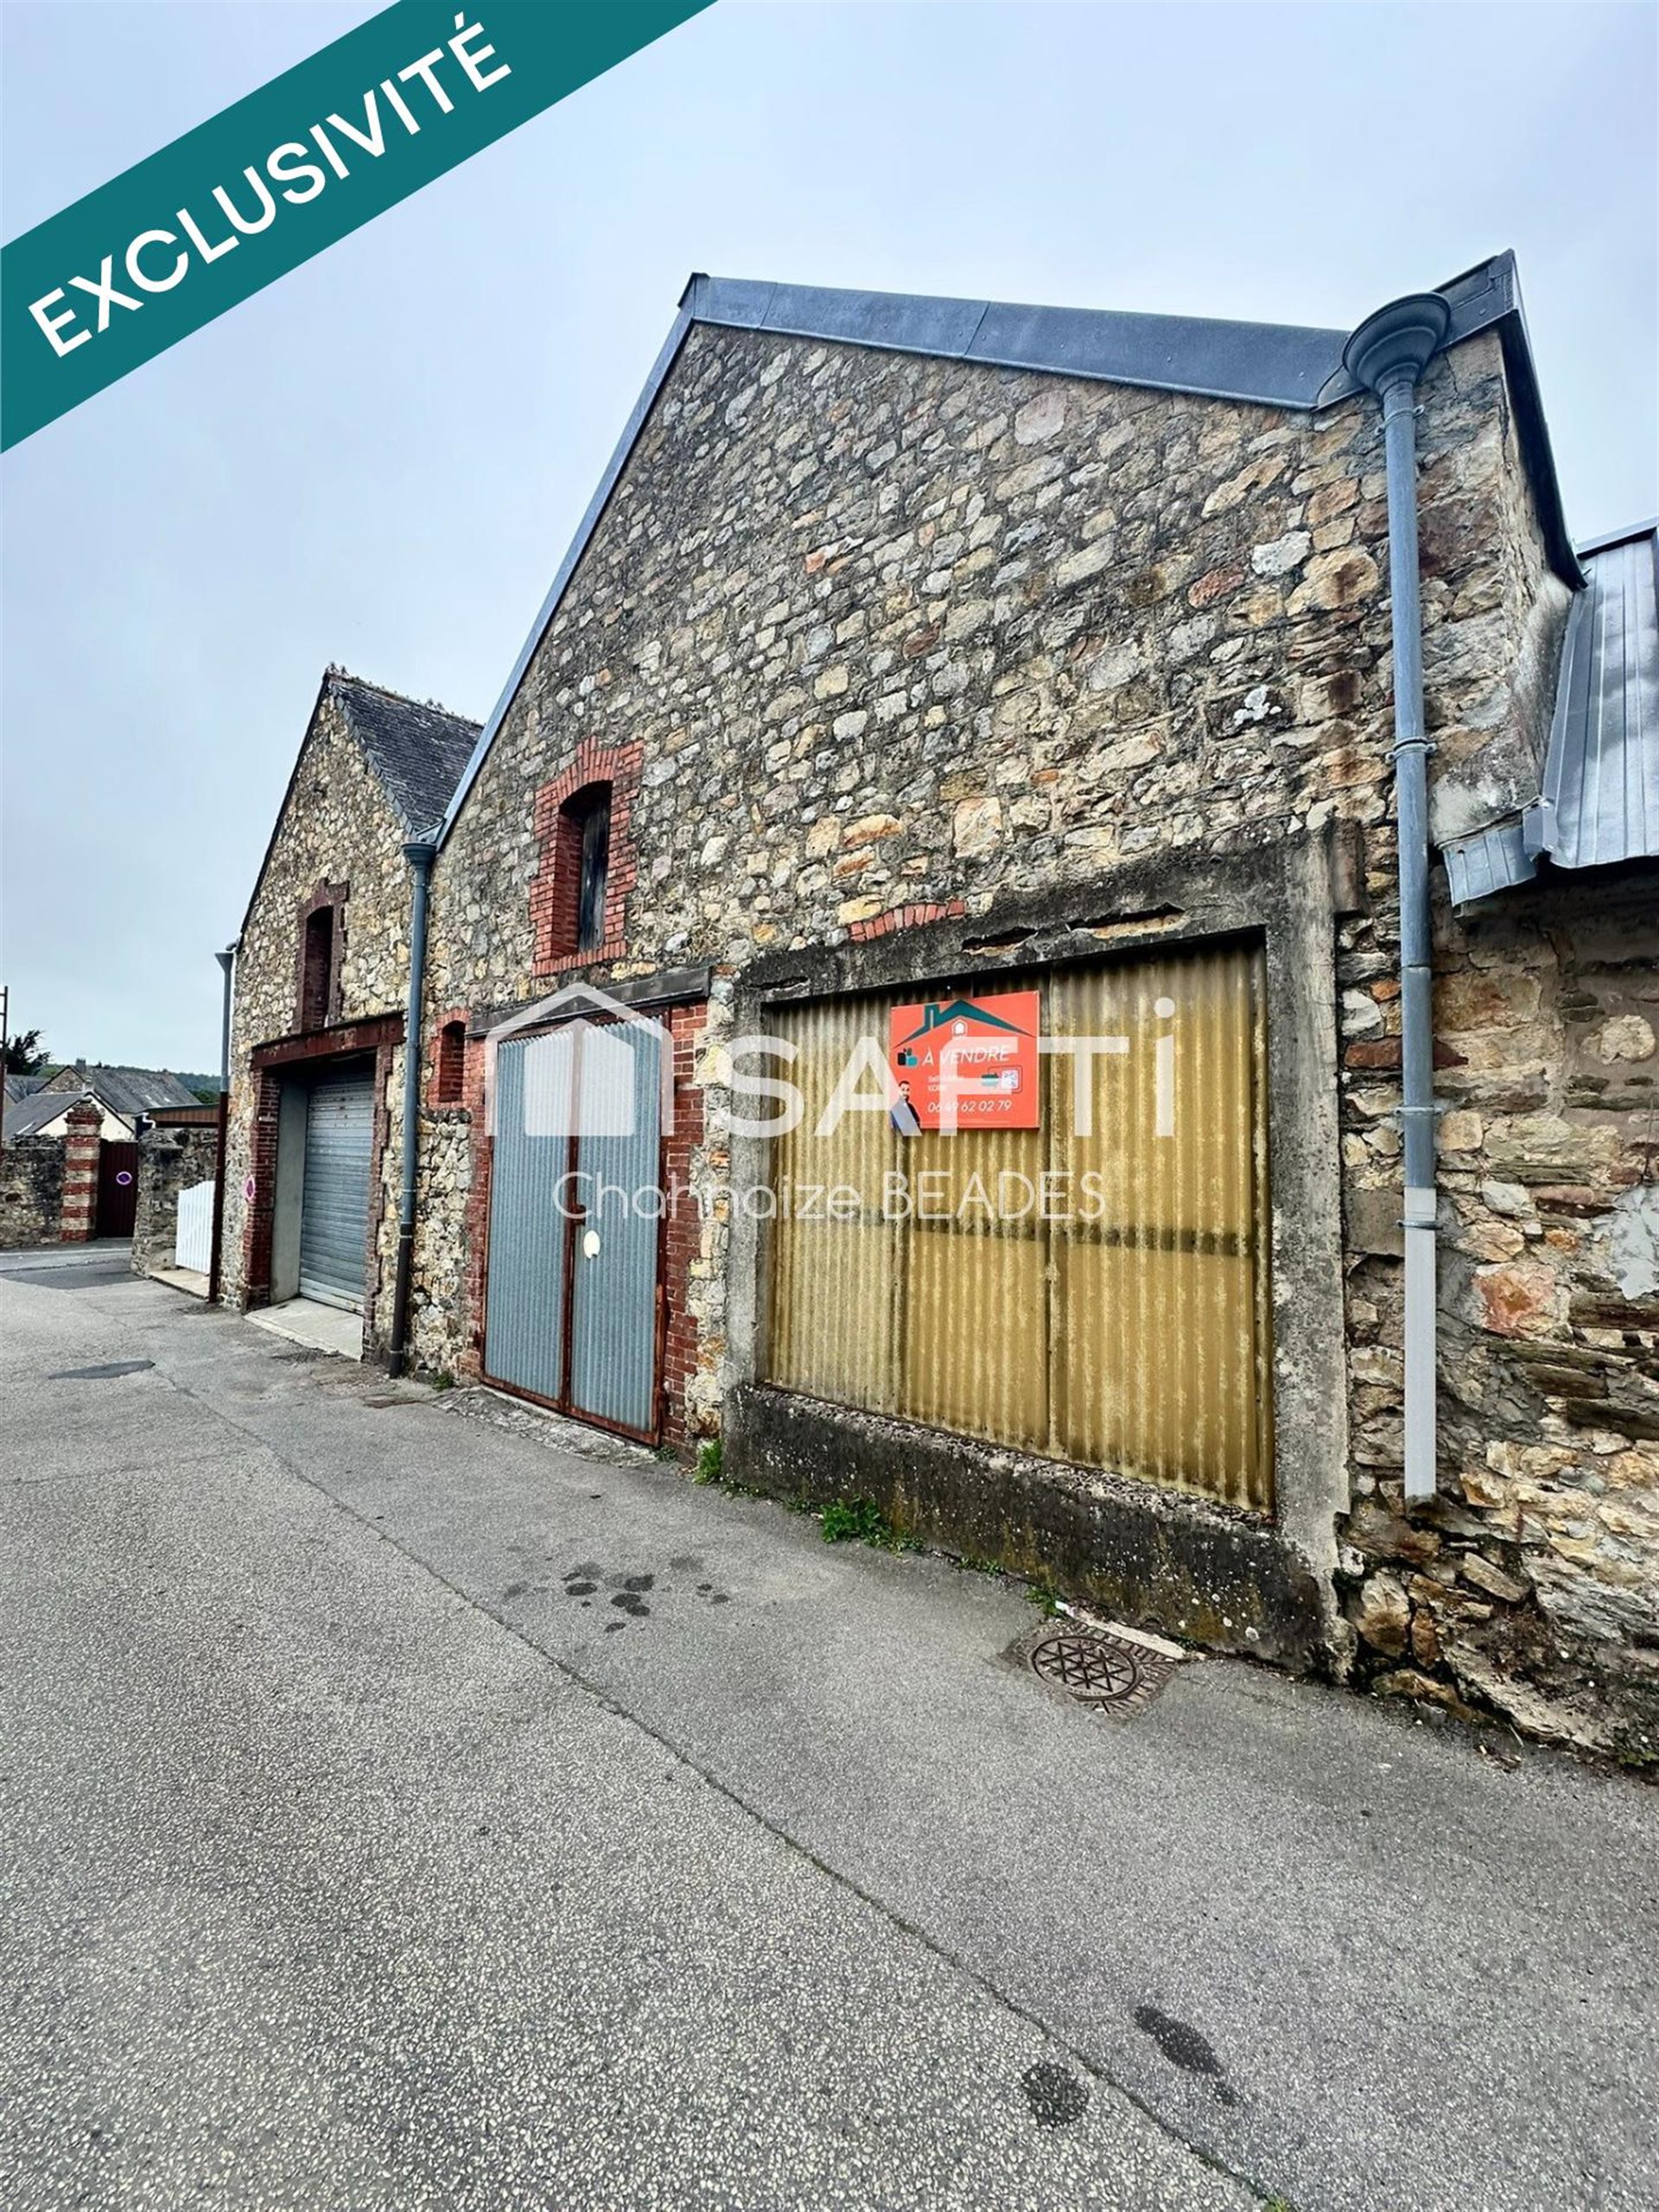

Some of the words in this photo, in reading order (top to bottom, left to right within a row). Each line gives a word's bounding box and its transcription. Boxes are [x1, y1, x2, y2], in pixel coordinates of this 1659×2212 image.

[922, 1047, 934, 1065] À
[940, 1046, 1009, 1065] VENDRE
[961, 1101, 976, 1112] 62
[978, 1100, 995, 1111] 02
[997, 1099, 1012, 1111] 79
